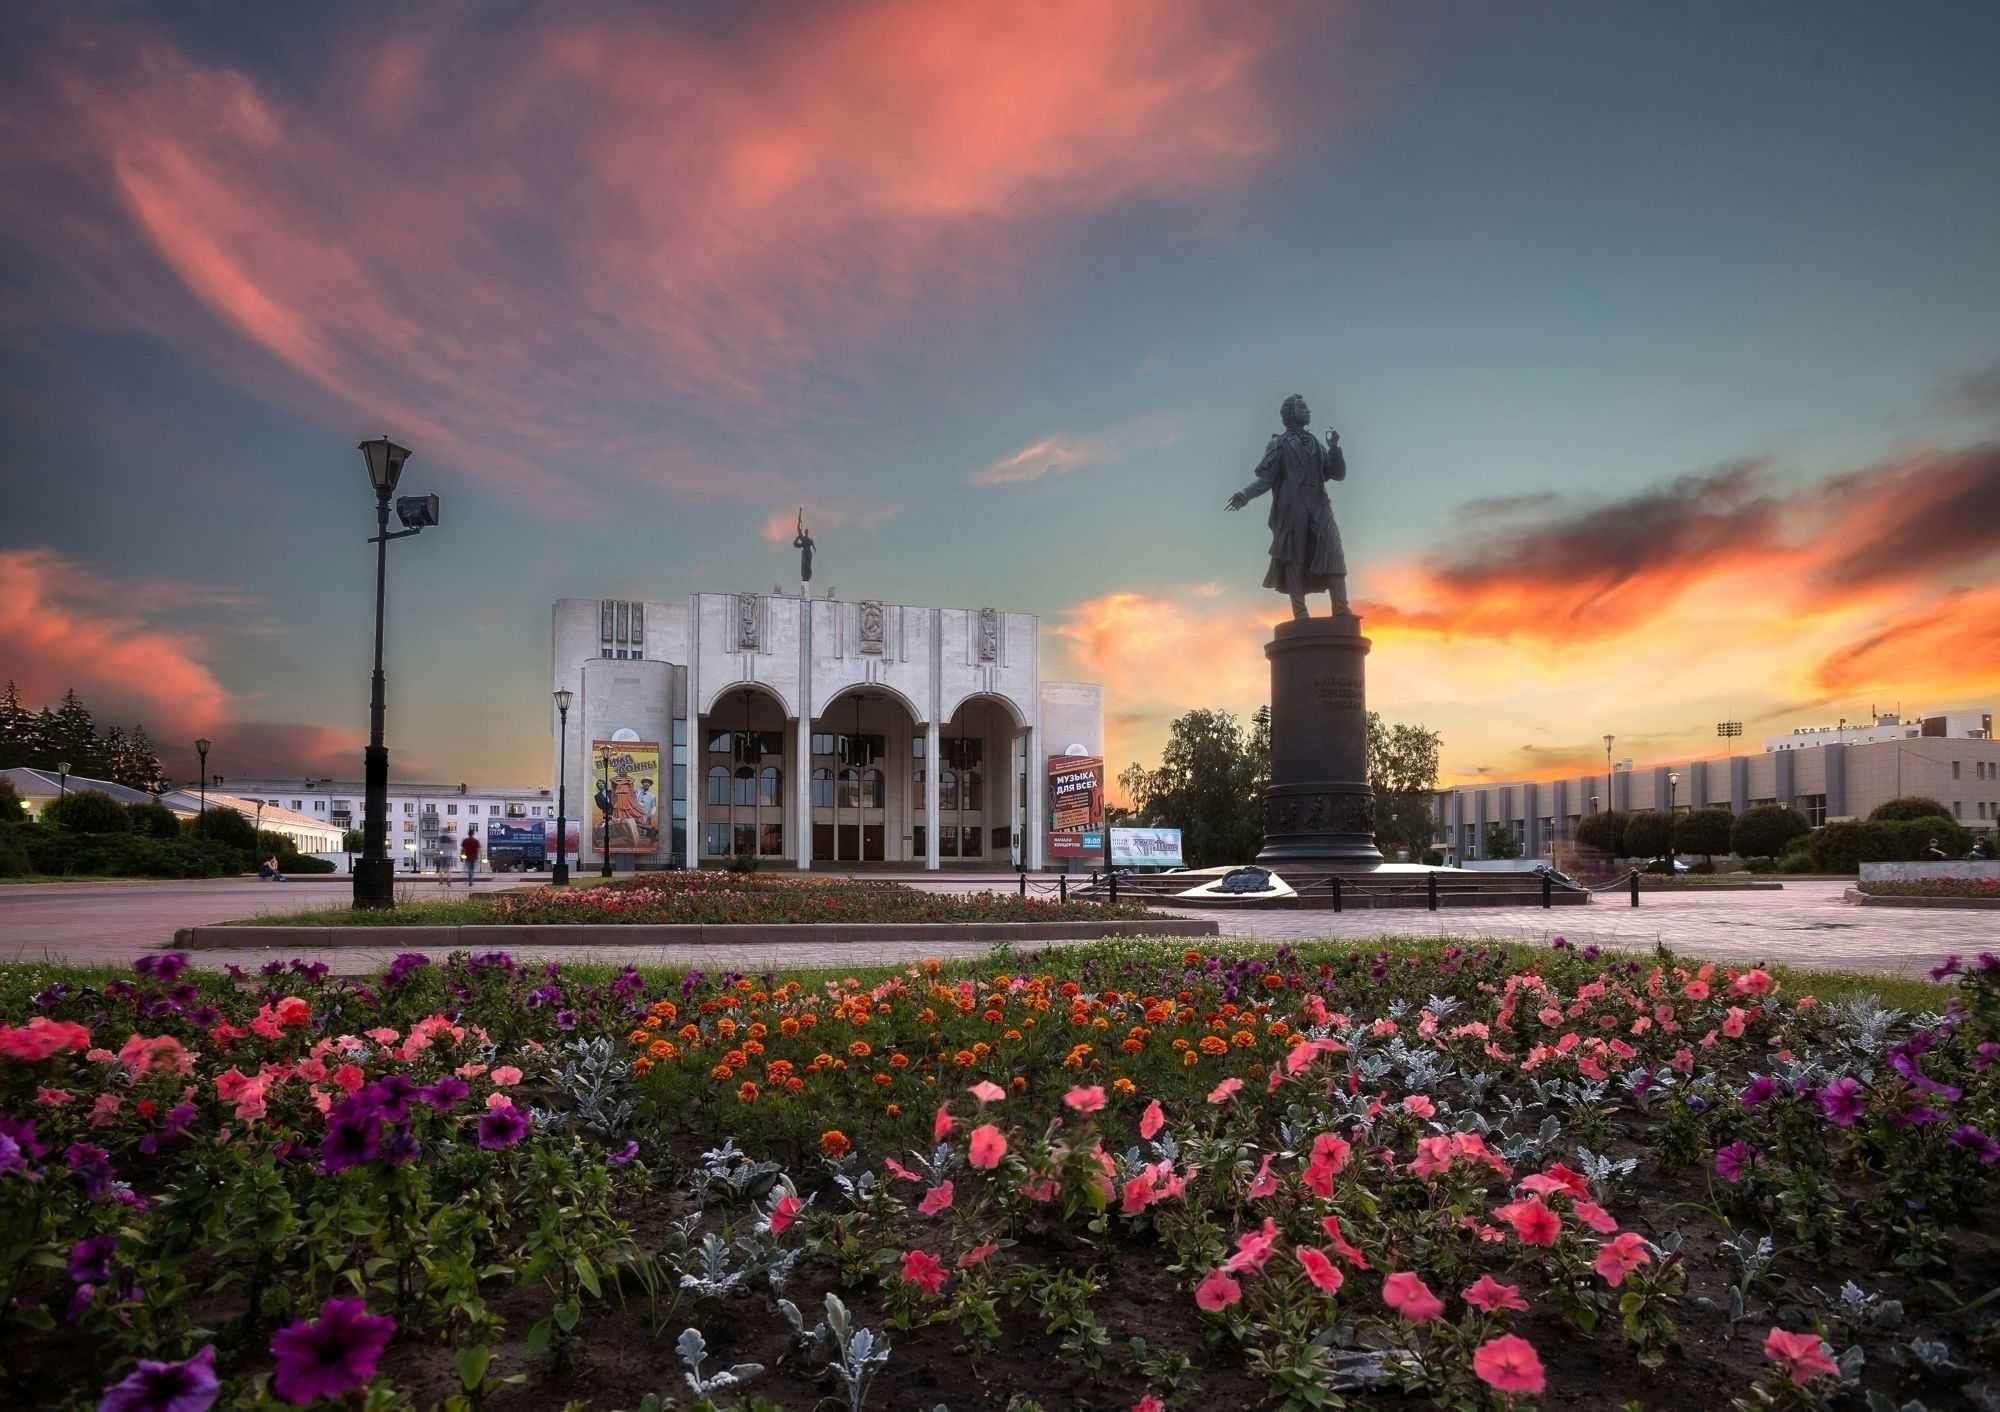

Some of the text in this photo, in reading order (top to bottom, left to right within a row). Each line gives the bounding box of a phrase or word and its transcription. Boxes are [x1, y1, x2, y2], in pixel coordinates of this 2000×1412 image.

[1056, 771, 1094, 784] МУЗЫКА
[1056, 780, 1097, 795] ДЛЯ ВСЕХ
